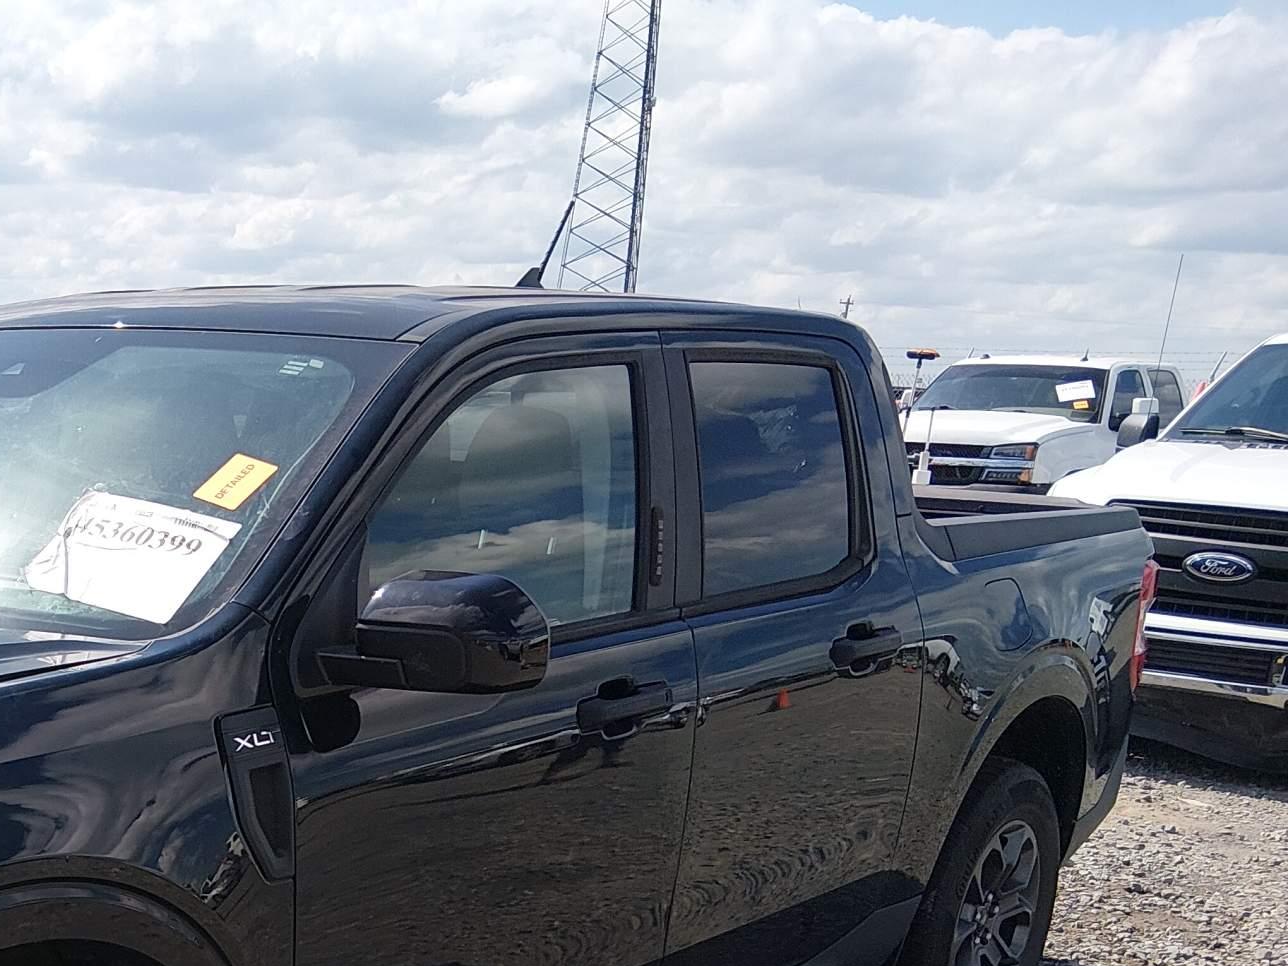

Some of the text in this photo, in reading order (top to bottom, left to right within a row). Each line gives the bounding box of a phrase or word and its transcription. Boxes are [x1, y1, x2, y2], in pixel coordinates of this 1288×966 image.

[214, 464, 256, 499] DETAILED
[72, 515, 203, 556] 45360399
[233, 731, 274, 752] XLT
